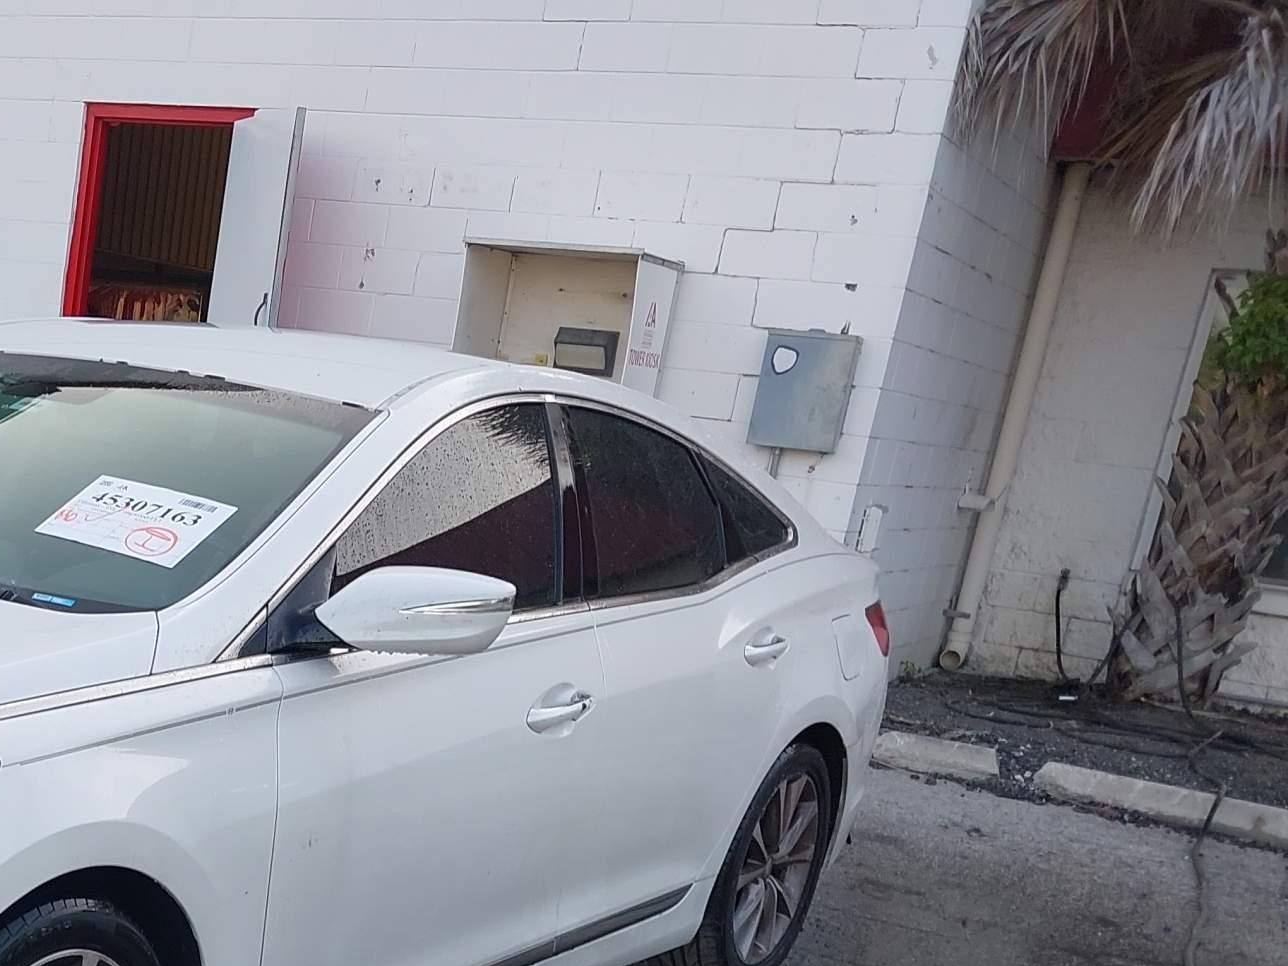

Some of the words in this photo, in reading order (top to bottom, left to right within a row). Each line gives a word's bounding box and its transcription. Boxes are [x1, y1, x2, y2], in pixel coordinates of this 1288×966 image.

[629, 348, 646, 366] TOWER
[644, 351, 661, 368] KIOSK
[92, 492, 202, 526] 45307163
